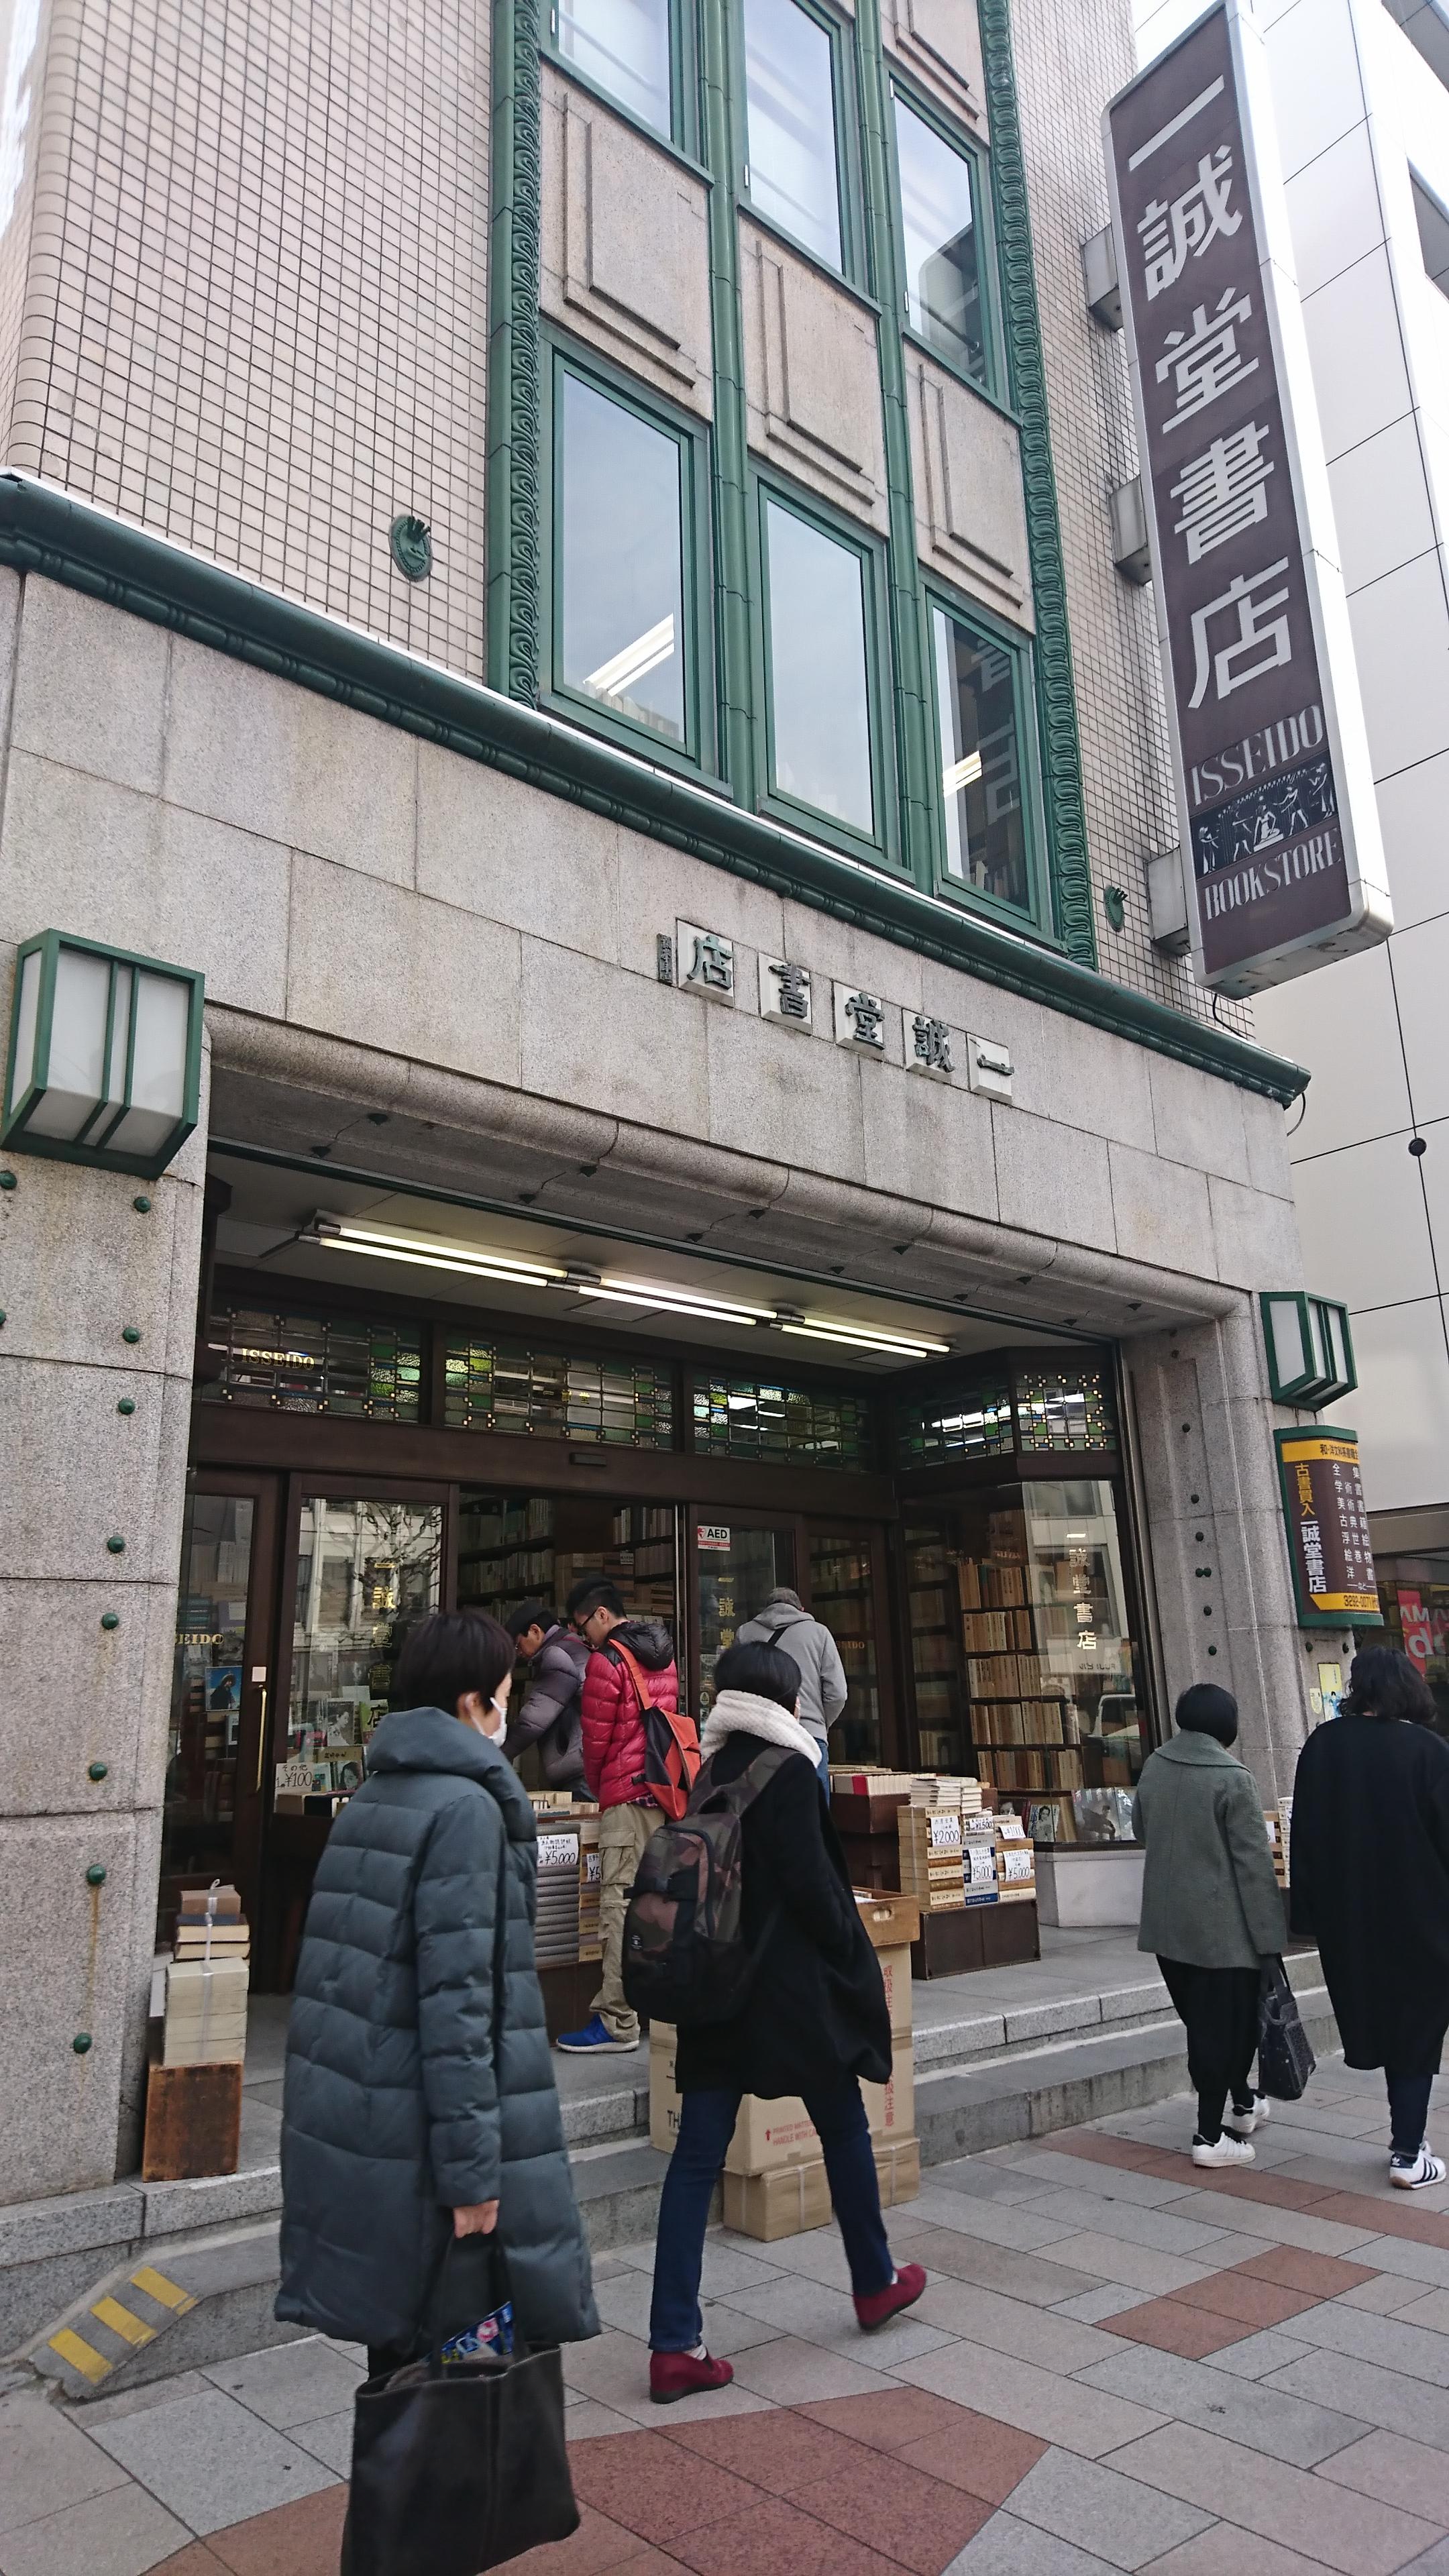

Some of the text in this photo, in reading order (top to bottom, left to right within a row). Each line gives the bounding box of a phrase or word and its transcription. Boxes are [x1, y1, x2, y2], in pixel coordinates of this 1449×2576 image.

[1128, 74, 1292, 708] 一誠堂書店
[1191, 704, 1324, 806] ISSEIDO
[1203, 827, 1342, 922] BOOKSTORE
[241, 1348, 315, 1371] ISSEIDO
[1295, 1463, 1316, 1516] 古書買入
[707, 1528, 727, 1538] AED
[1300, 1520, 1328, 1593] 一誠堂書店
[1066, 1532, 1097, 1650] 一誠堂書店
[174, 1633, 225, 1645] EIDO
[285, 1772, 313, 1787] ¥100
[773, 2133, 794, 2146] HANDLE
[795, 2130, 808, 2141] WITH
